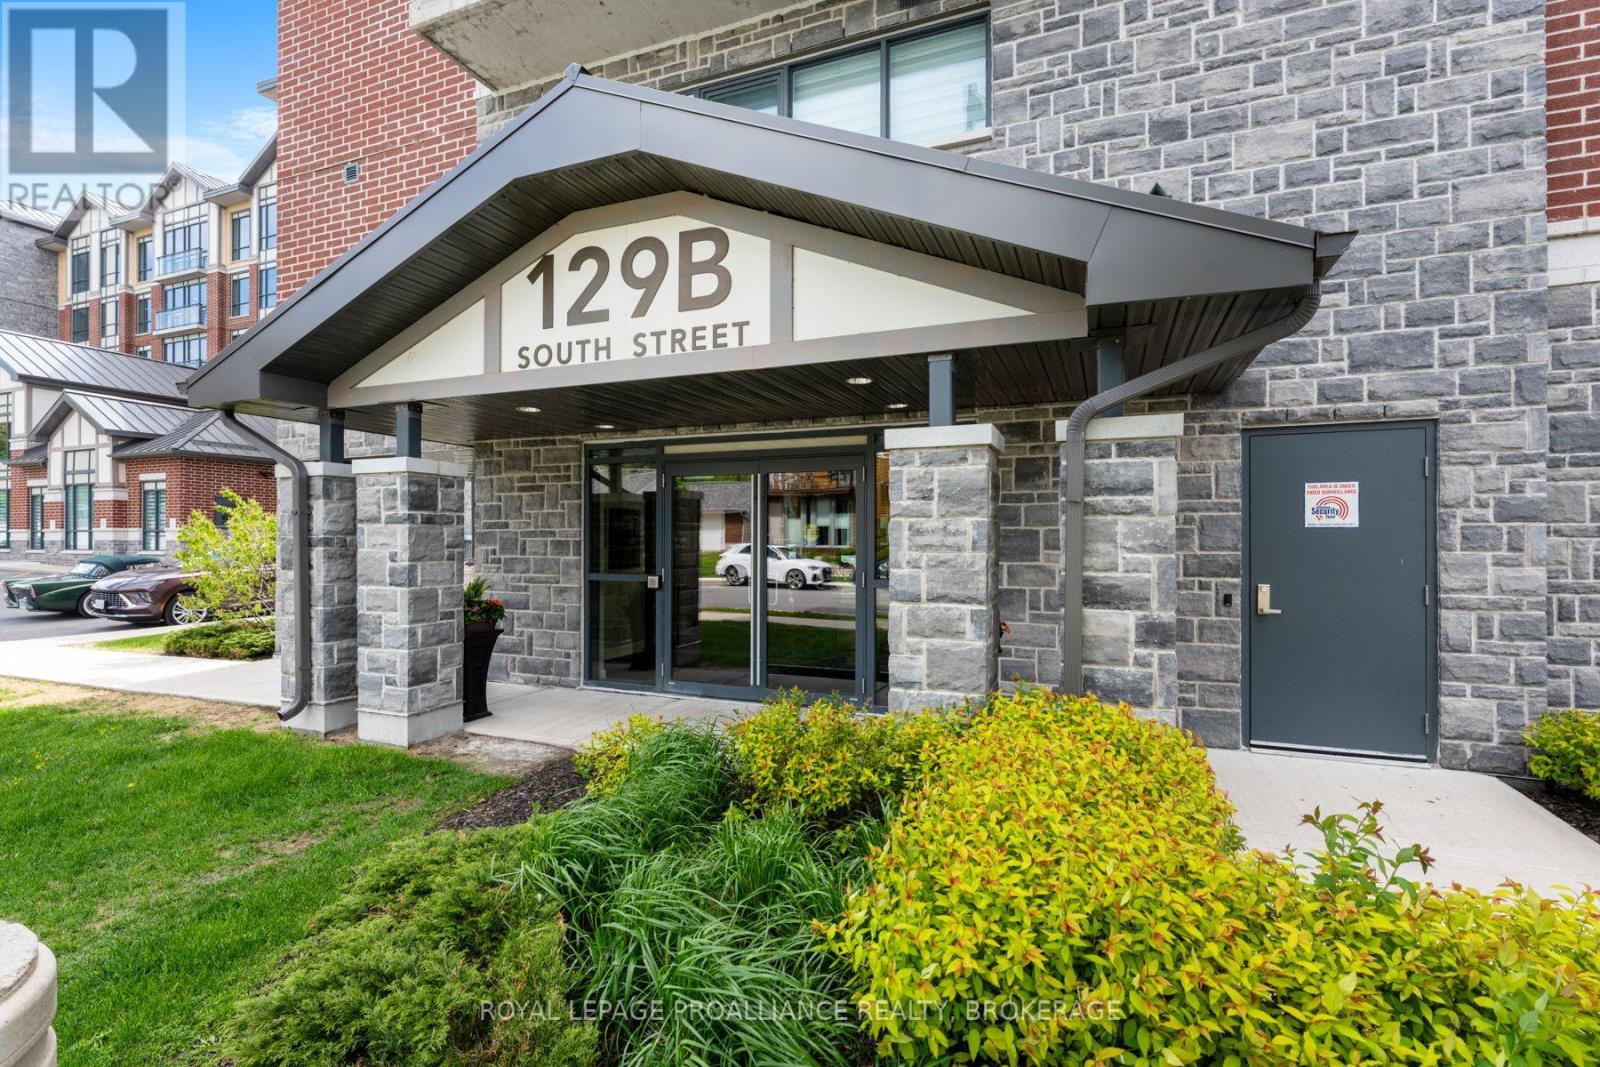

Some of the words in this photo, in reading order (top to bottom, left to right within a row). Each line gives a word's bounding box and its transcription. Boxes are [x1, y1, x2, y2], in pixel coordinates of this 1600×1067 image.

[526, 226, 732, 330] 129B
[517, 336, 611, 369] SOUTH
[633, 320, 750, 358] STREET
[1311, 507, 1339, 516] Security
